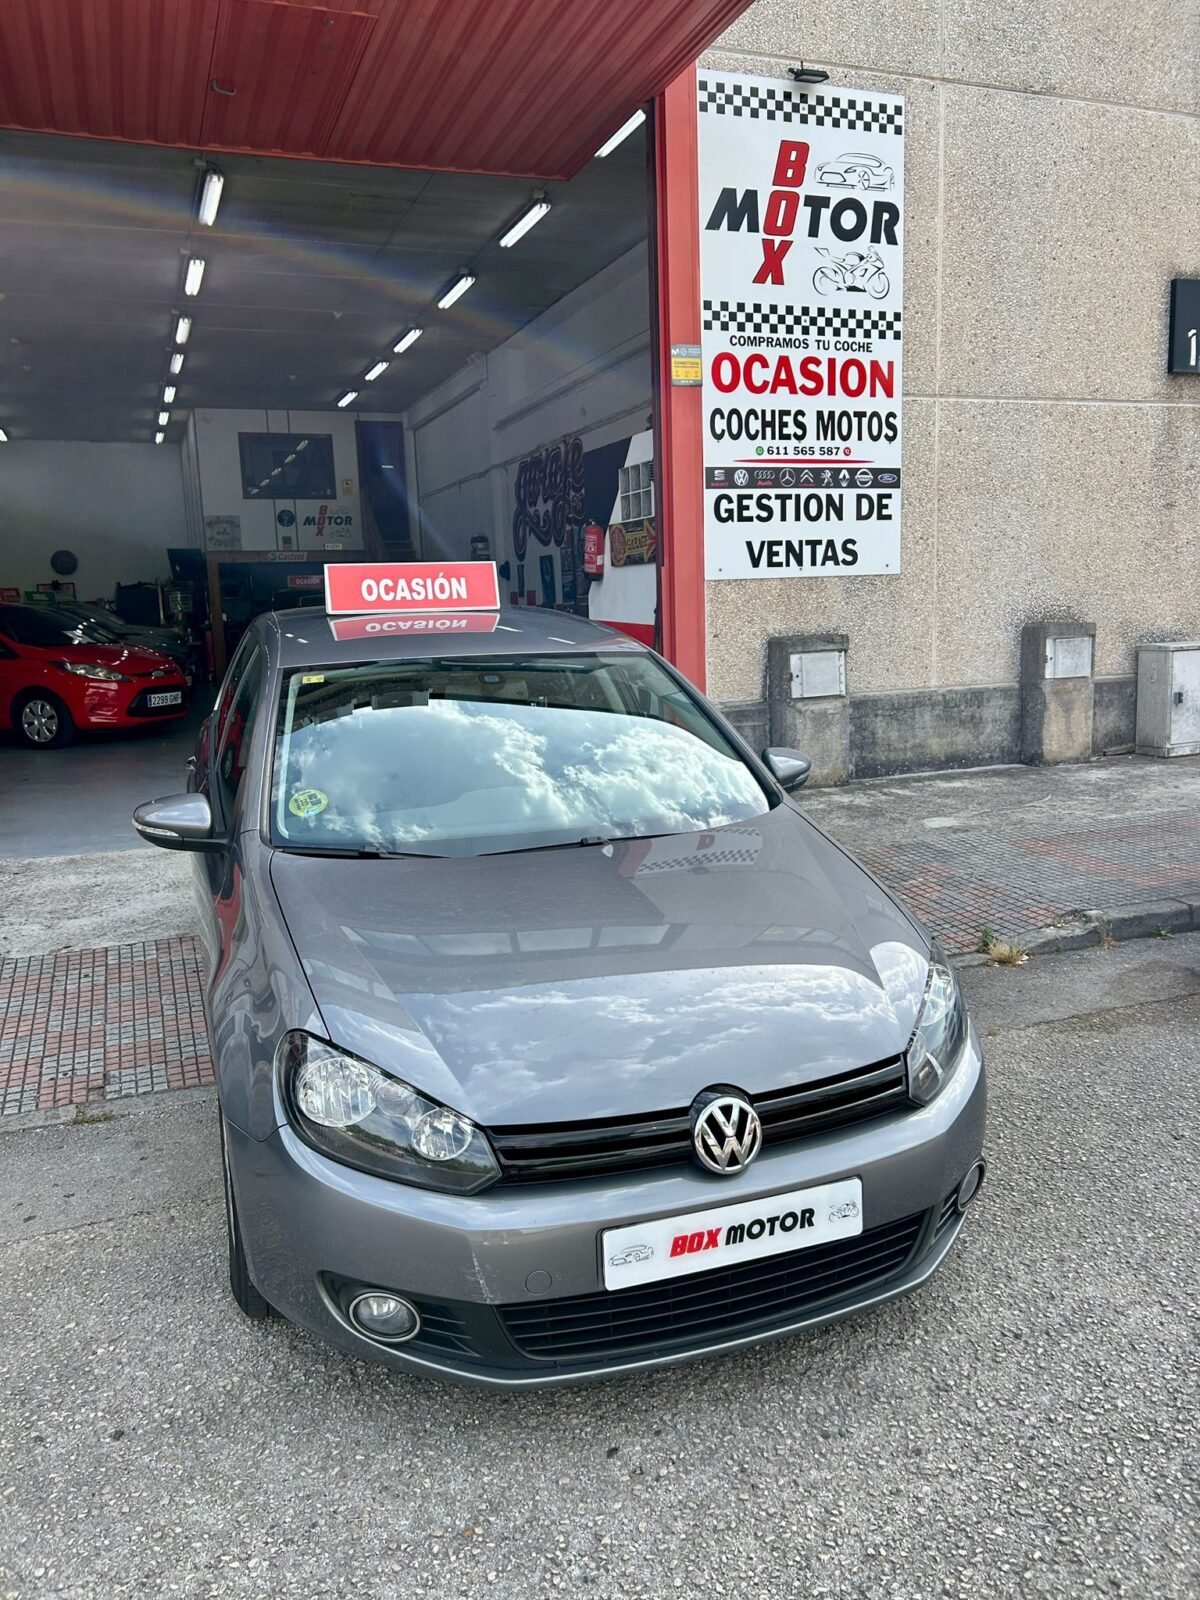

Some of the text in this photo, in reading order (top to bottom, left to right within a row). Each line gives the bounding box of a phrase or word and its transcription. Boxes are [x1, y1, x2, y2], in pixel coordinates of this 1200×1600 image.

[752, 139, 810, 286] BOX
[729, 335, 873, 353] COMPRAMOS TU COCHE
[711, 351, 894, 398] OCASION
[709, 407, 898, 442] COCHES MOTOS
[767, 446, 841, 456] 611 565 587
[713, 493, 893, 523] GESTION DE
[745, 538, 859, 568] VENTAS
[361, 572, 468, 602] OCASIÓN
[152, 695, 168, 705] 2299
[669, 1207, 816, 1258] BOX MOTOR
